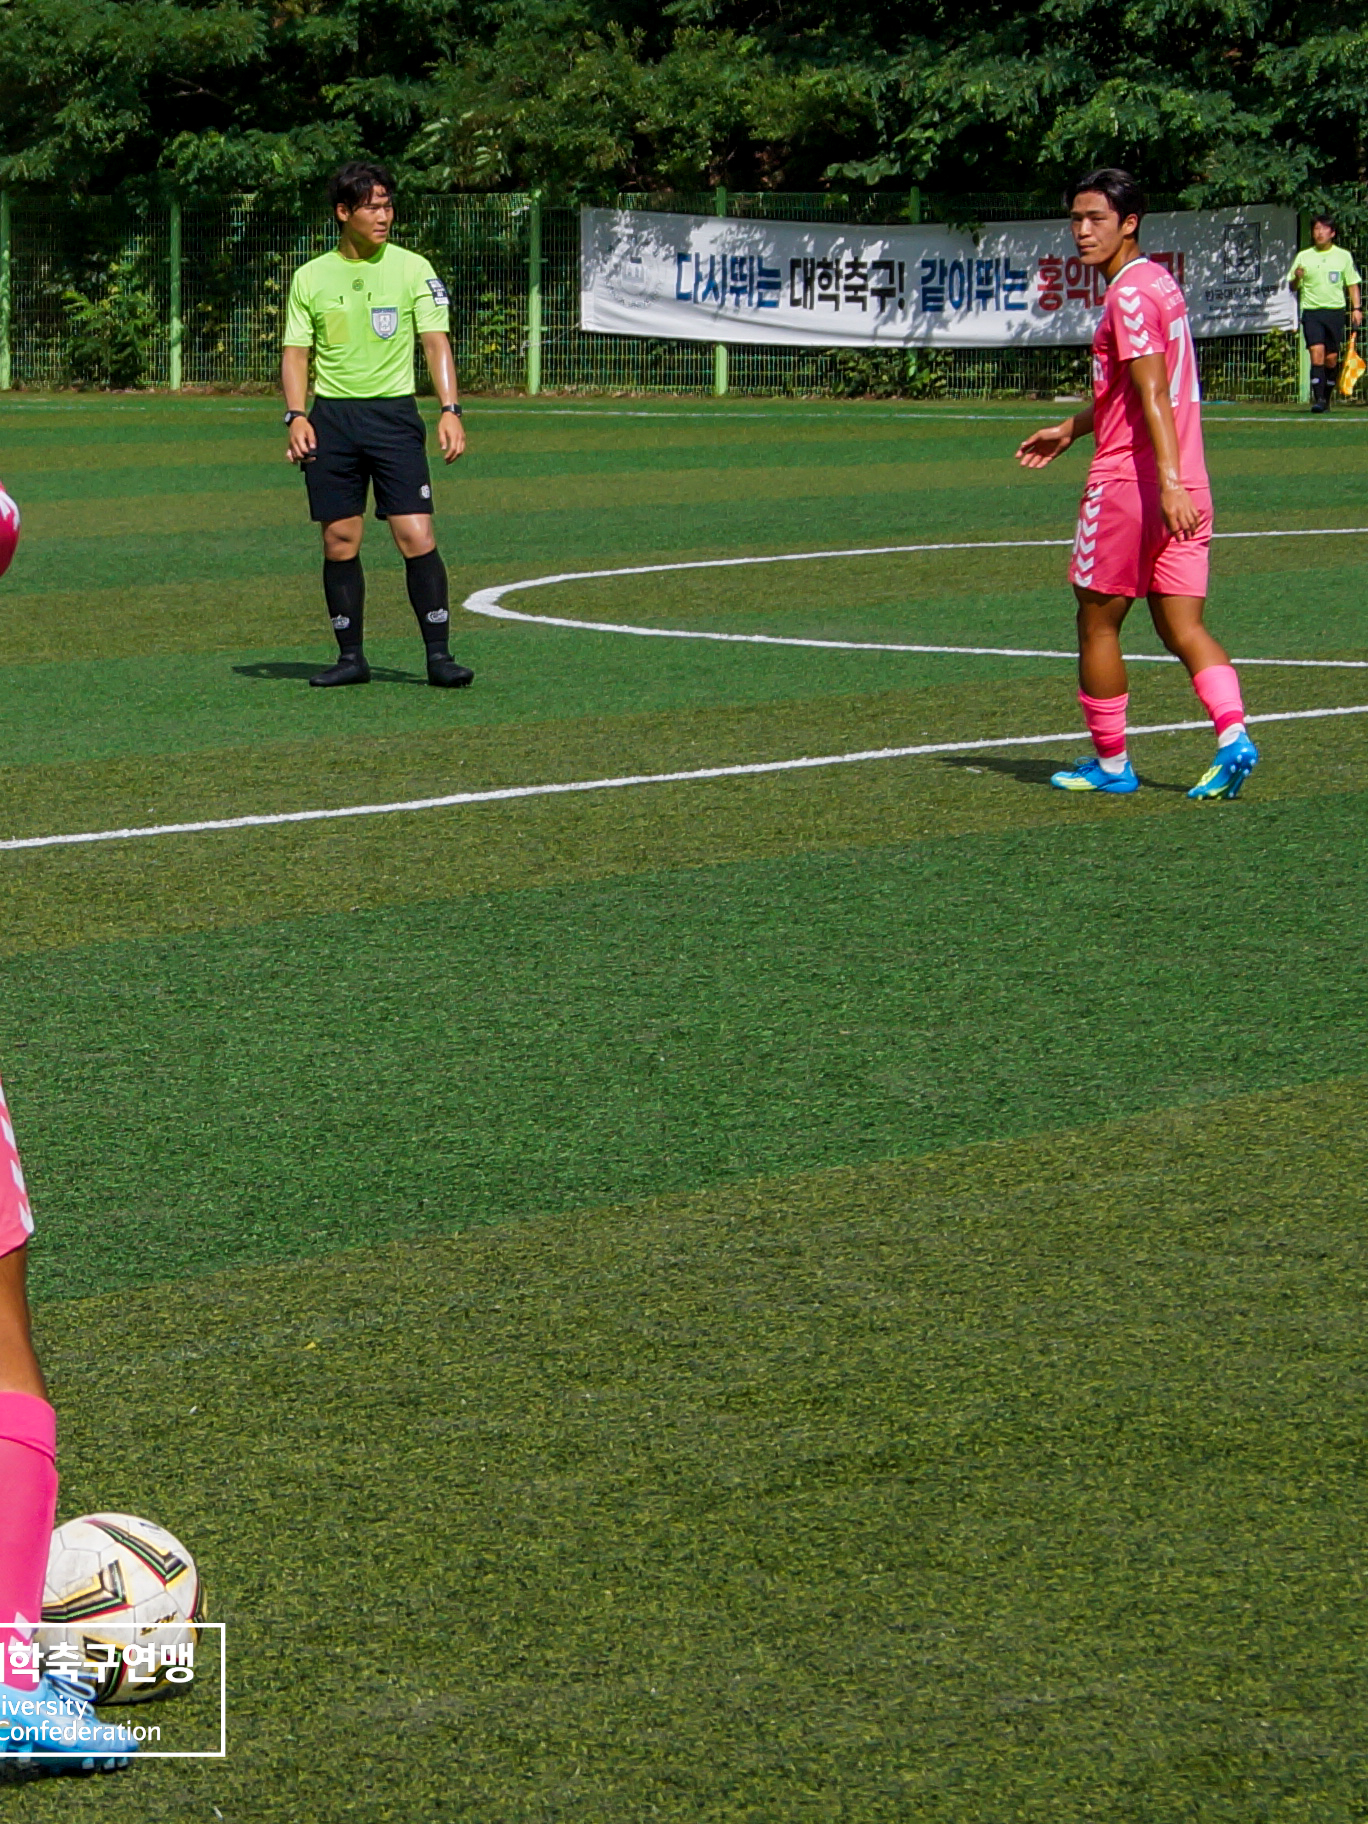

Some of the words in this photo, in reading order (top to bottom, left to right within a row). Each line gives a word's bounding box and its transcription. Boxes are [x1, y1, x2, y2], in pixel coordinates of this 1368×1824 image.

[675, 252, 781, 309] 다시뛰는
[789, 256, 906, 312] 대학축구!
[920, 257, 1028, 312] 같이뛰는
